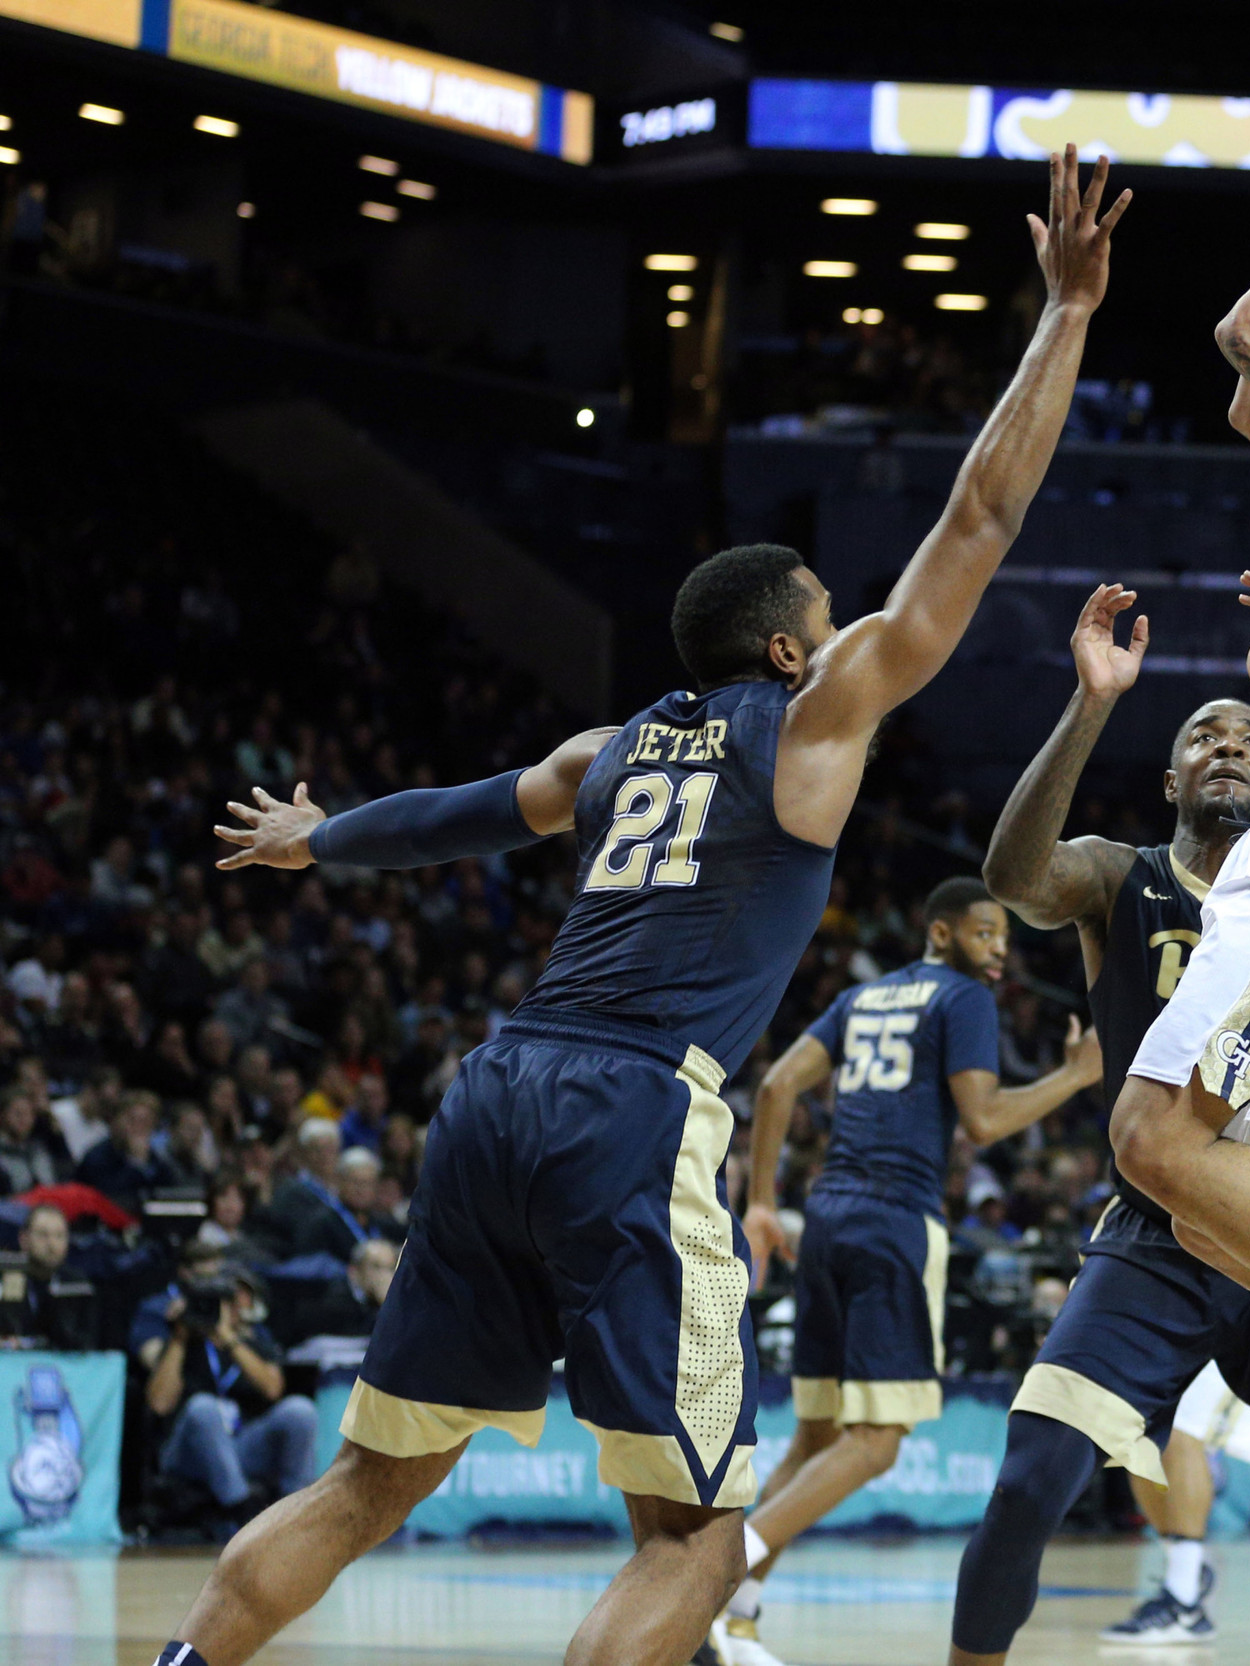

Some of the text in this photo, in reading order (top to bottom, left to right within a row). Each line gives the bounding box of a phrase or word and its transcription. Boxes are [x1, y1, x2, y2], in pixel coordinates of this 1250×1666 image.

[626, 719, 729, 765] JETER
[584, 772, 719, 893] 21
[838, 1013, 920, 1093] 55
